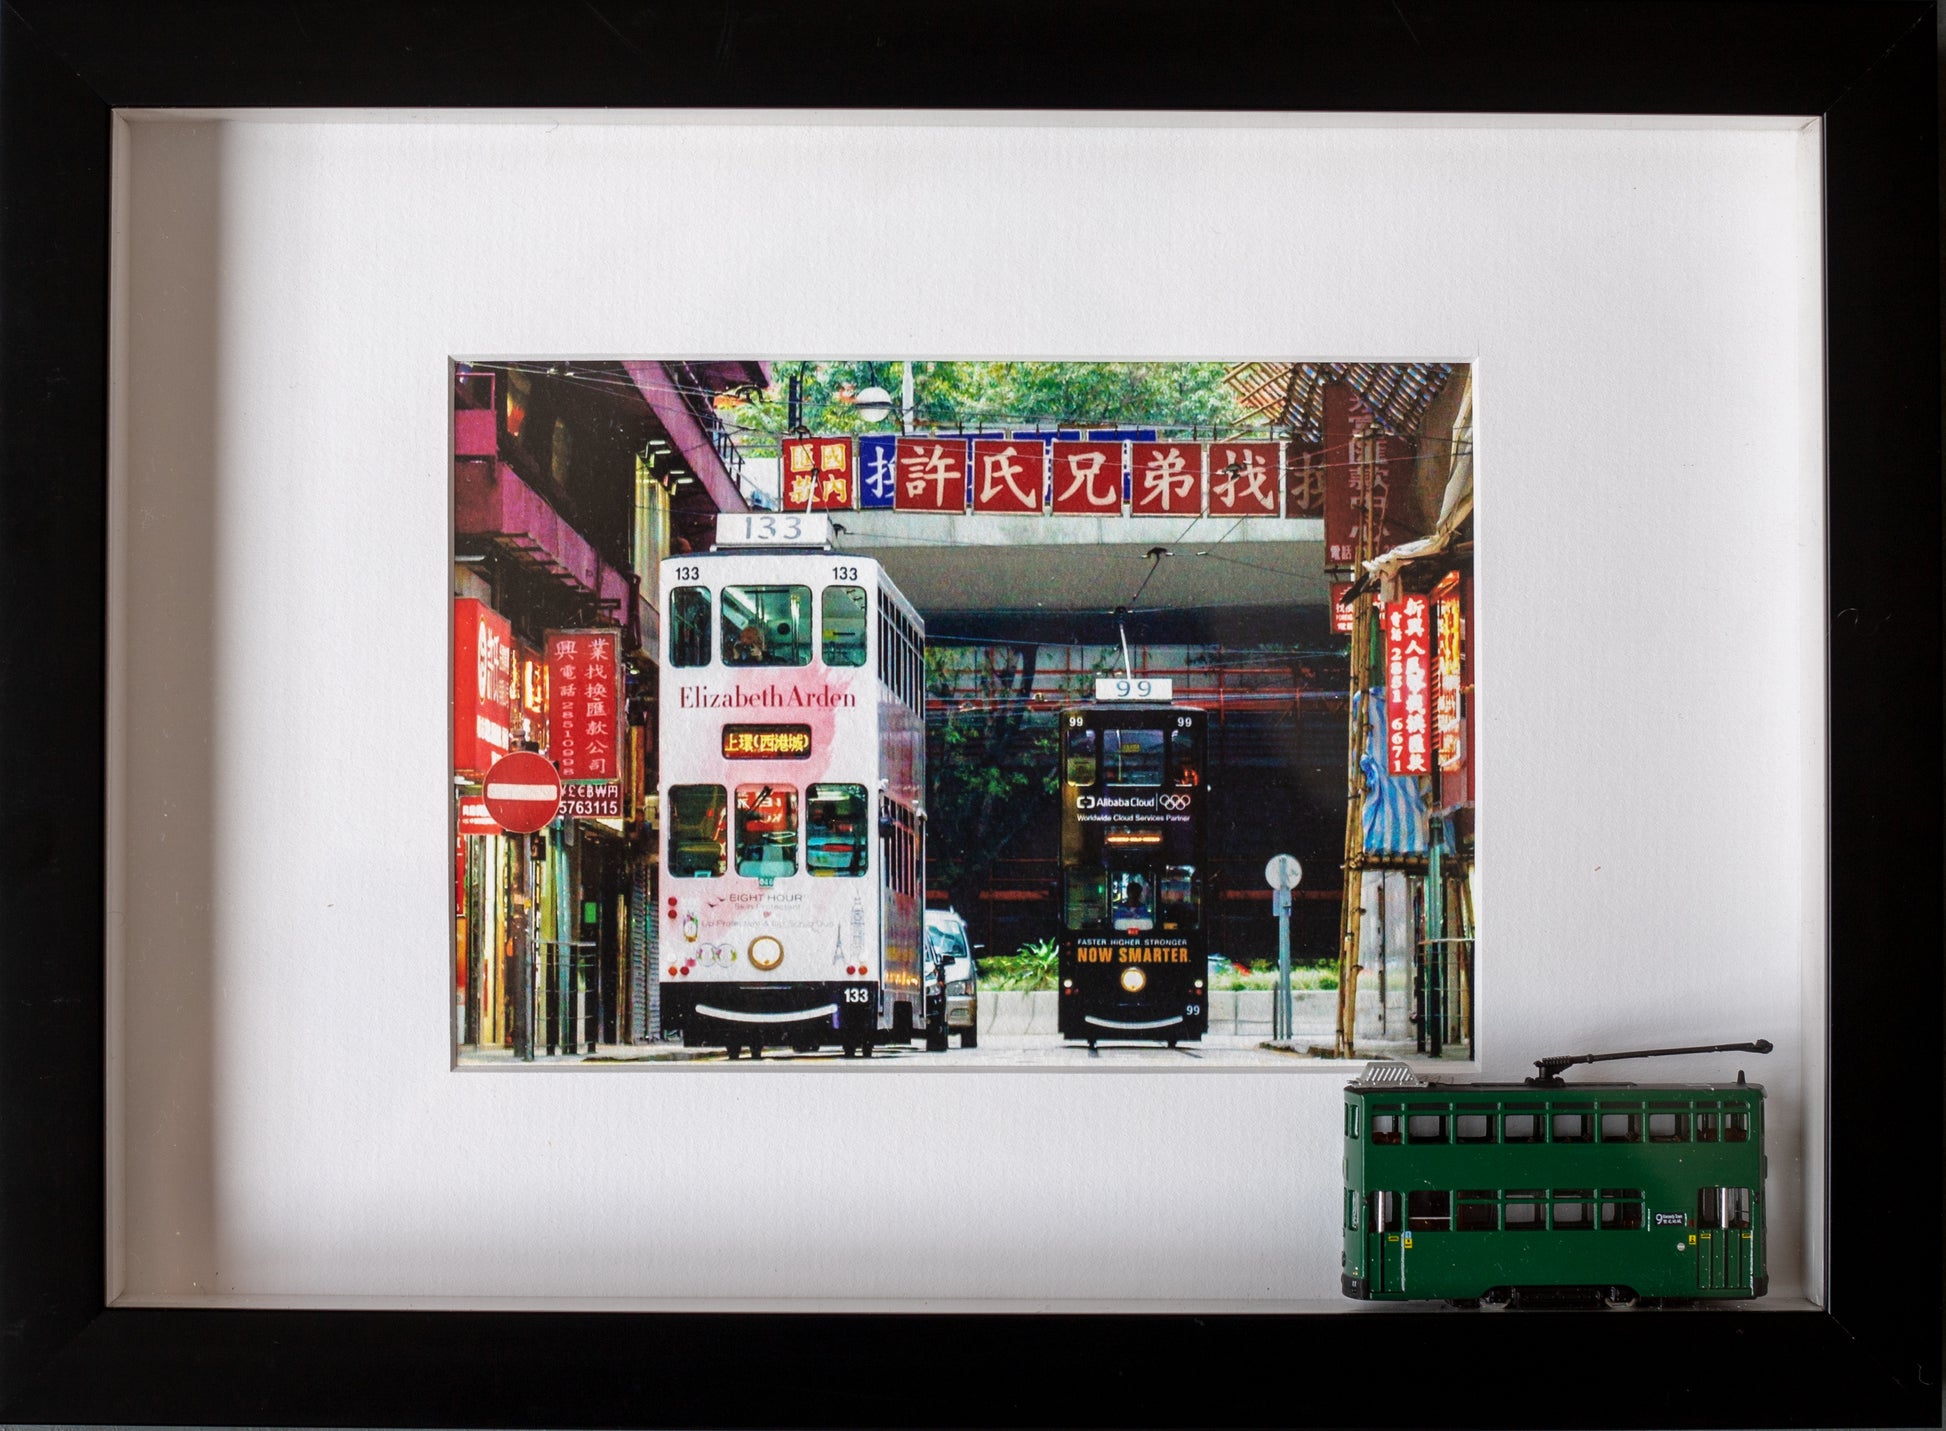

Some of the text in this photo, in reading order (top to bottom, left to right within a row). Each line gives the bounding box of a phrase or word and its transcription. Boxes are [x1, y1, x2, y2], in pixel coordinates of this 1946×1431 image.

[745, 516, 802, 540] 133
[675, 566, 700, 581] 133
[832, 566, 858, 581] 133
[1116, 680, 1152, 698] 99
[680, 684, 856, 709] Elizabeth Arden
[1069, 716, 1084, 727] 99
[1177, 716, 1193, 728] 99
[1390, 718, 1403, 773] 6671
[1096, 795, 1155, 807] Alibaba Cloud
[1076, 814, 1191, 823] Worldwide Cloud Services Partner
[729, 893, 803, 903] EIGHT HOUR
[1077, 947, 1113, 963] NOW
[844, 989, 869, 1003] 133
[1186, 1004, 1200, 1016] 99
[1655, 1213, 1663, 1225] 9
